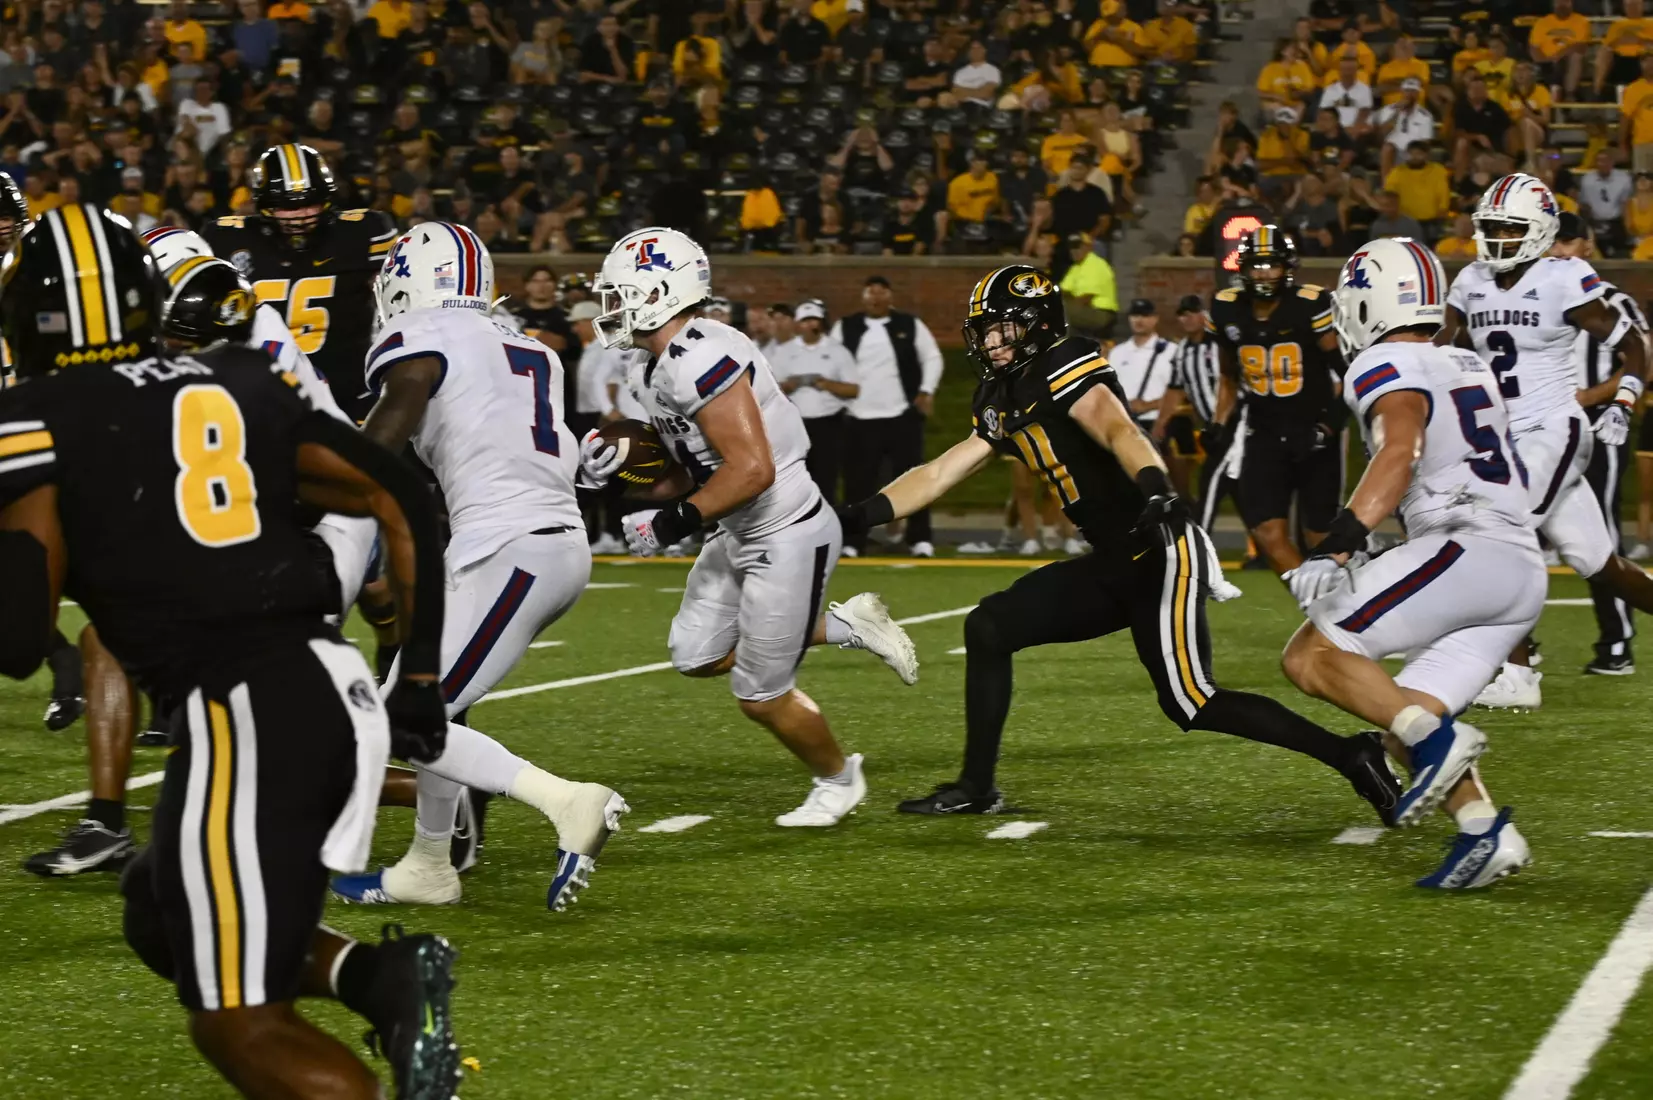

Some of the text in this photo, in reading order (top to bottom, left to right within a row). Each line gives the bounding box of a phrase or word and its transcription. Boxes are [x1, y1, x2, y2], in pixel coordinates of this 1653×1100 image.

[442, 299, 487, 311] BULLDOGS
[1471, 309, 1541, 329] BULLDOGS
[502, 342, 561, 458] 7
[1486, 331, 1521, 398] 2
[172, 384, 261, 548] 8
[1449, 385, 1529, 491] 5
